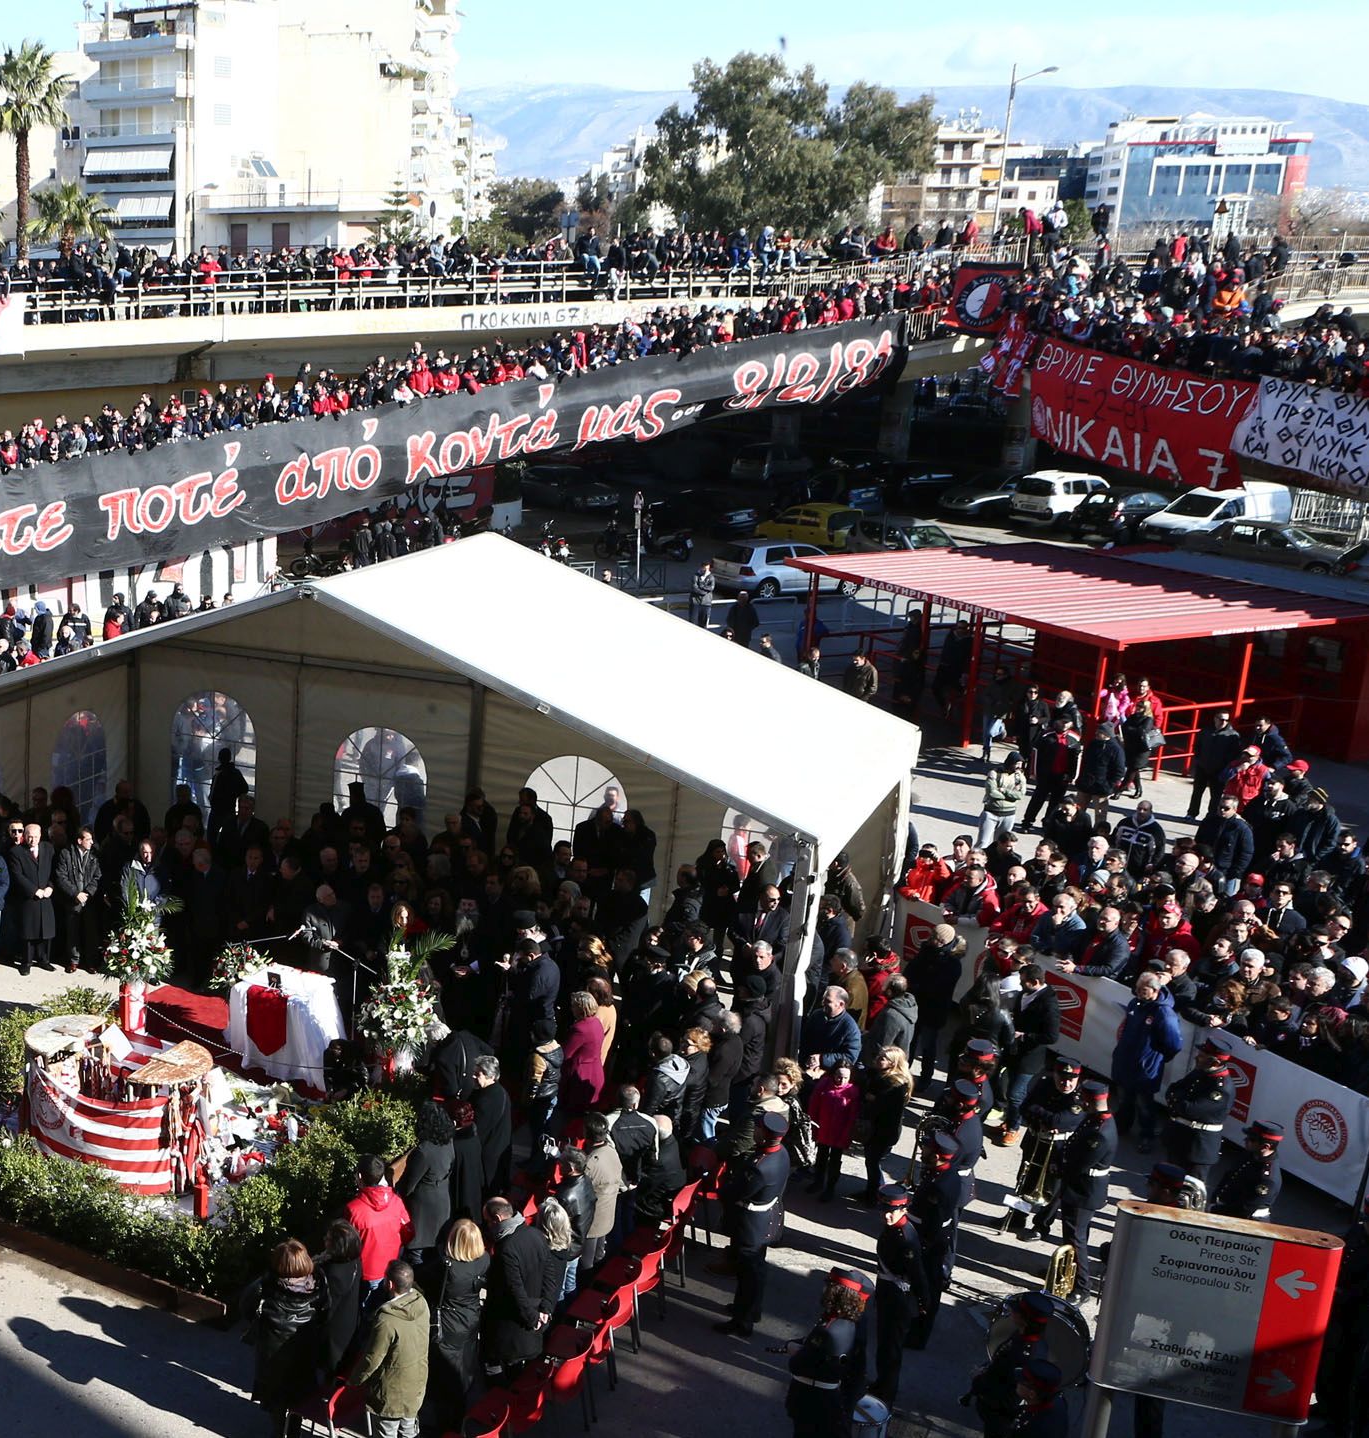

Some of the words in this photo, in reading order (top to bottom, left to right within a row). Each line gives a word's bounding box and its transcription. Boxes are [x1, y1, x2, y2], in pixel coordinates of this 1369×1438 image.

[1037, 343, 1103, 385] ΘΡΥΛΕ
[1111, 364, 1250, 418] ΘΥΜΗΣΟΥ
[1265, 379, 1321, 405] ΘΡΥΛΕ
[1046, 406, 1183, 481] ΝΙΚΑΙΑ
[1198, 448, 1229, 489] 7
[1276, 426, 1367, 462] ΘΕΛΟΥΝΕ
[1281, 448, 1302, 467] ΟΙ
[99, 442, 245, 541] ποτέ
[275, 418, 381, 505] από
[863, 577, 929, 602] ΕΚΔΟΤΗΡΙΑ
[932, 595, 1007, 621] ΕΙΣΙΤΗΡΙΩΝ
[1169, 1229, 1201, 1245] Οδός
[1205, 1235, 1262, 1255] Πειραιώς
[1159, 1254, 1256, 1280] Σοφιανοπούλου
[1199, 1248, 1235, 1264] Pireos
[1239, 1254, 1258, 1267] Str.
[1151, 1266, 1230, 1290] Sofianopoulou
[1233, 1280, 1252, 1294] Str.
[1150, 1339, 1201, 1359] Σταθμός
